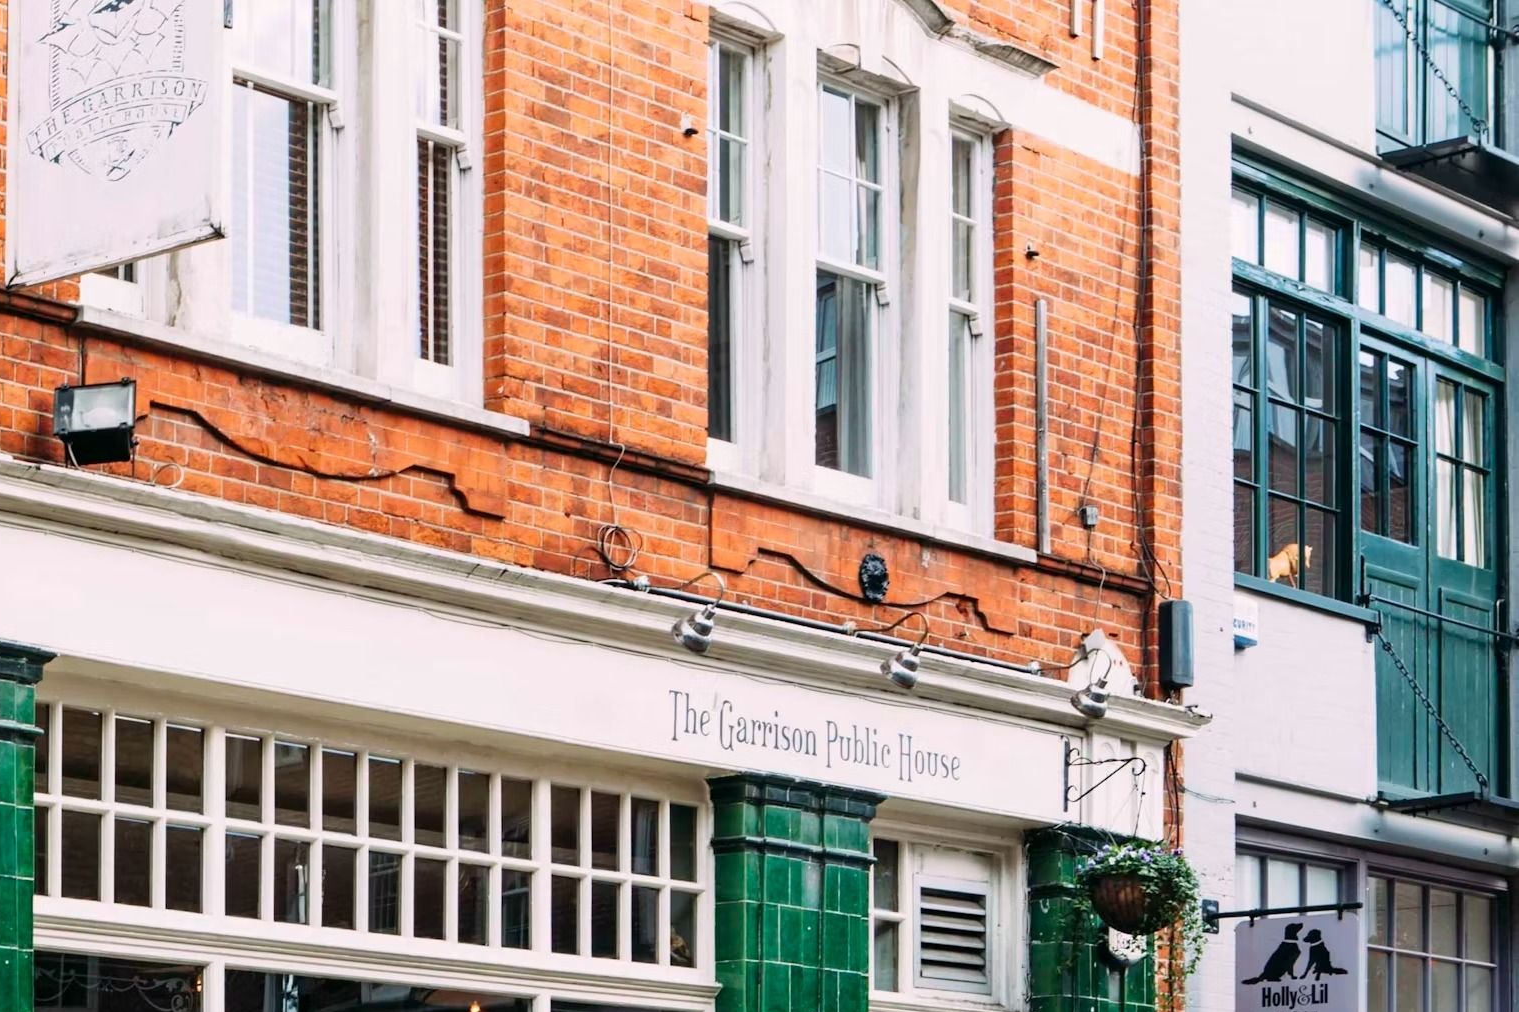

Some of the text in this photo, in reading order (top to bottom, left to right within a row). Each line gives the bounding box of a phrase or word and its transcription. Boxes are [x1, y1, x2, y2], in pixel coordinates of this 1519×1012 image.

[33, 79, 203, 145] THE GARRISON
[669, 690, 961, 782] The Garrison Public House
